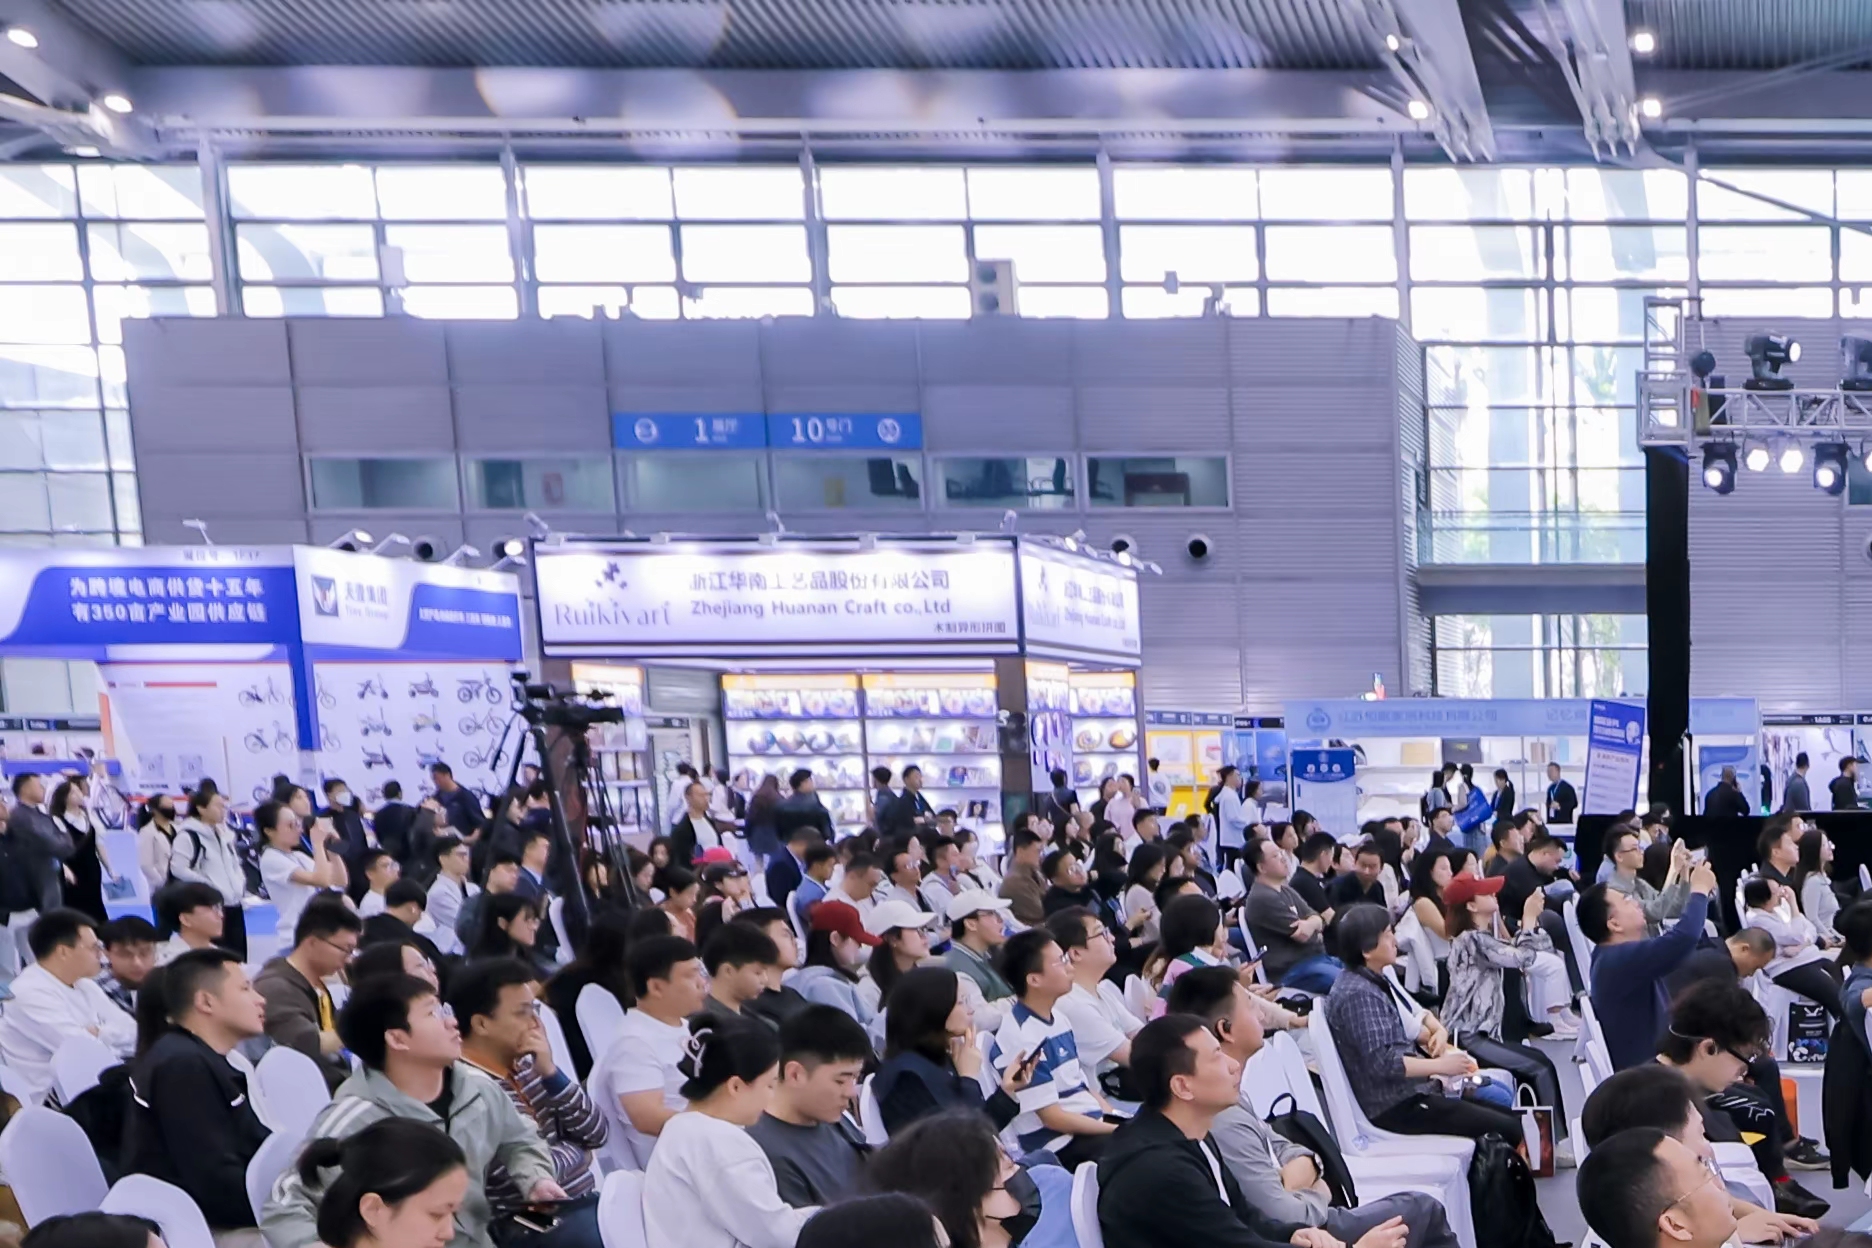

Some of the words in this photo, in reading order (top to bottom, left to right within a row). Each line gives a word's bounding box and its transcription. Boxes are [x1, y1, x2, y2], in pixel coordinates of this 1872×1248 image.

[694, 417, 708, 442] 1
[792, 417, 823, 442] 10
[690, 570, 950, 591] 浙江华南工艺品股份有限公司
[690, 600, 764, 618] Zhejiang
[772, 600, 837, 615] Huanan
[845, 599, 887, 615] Craft
